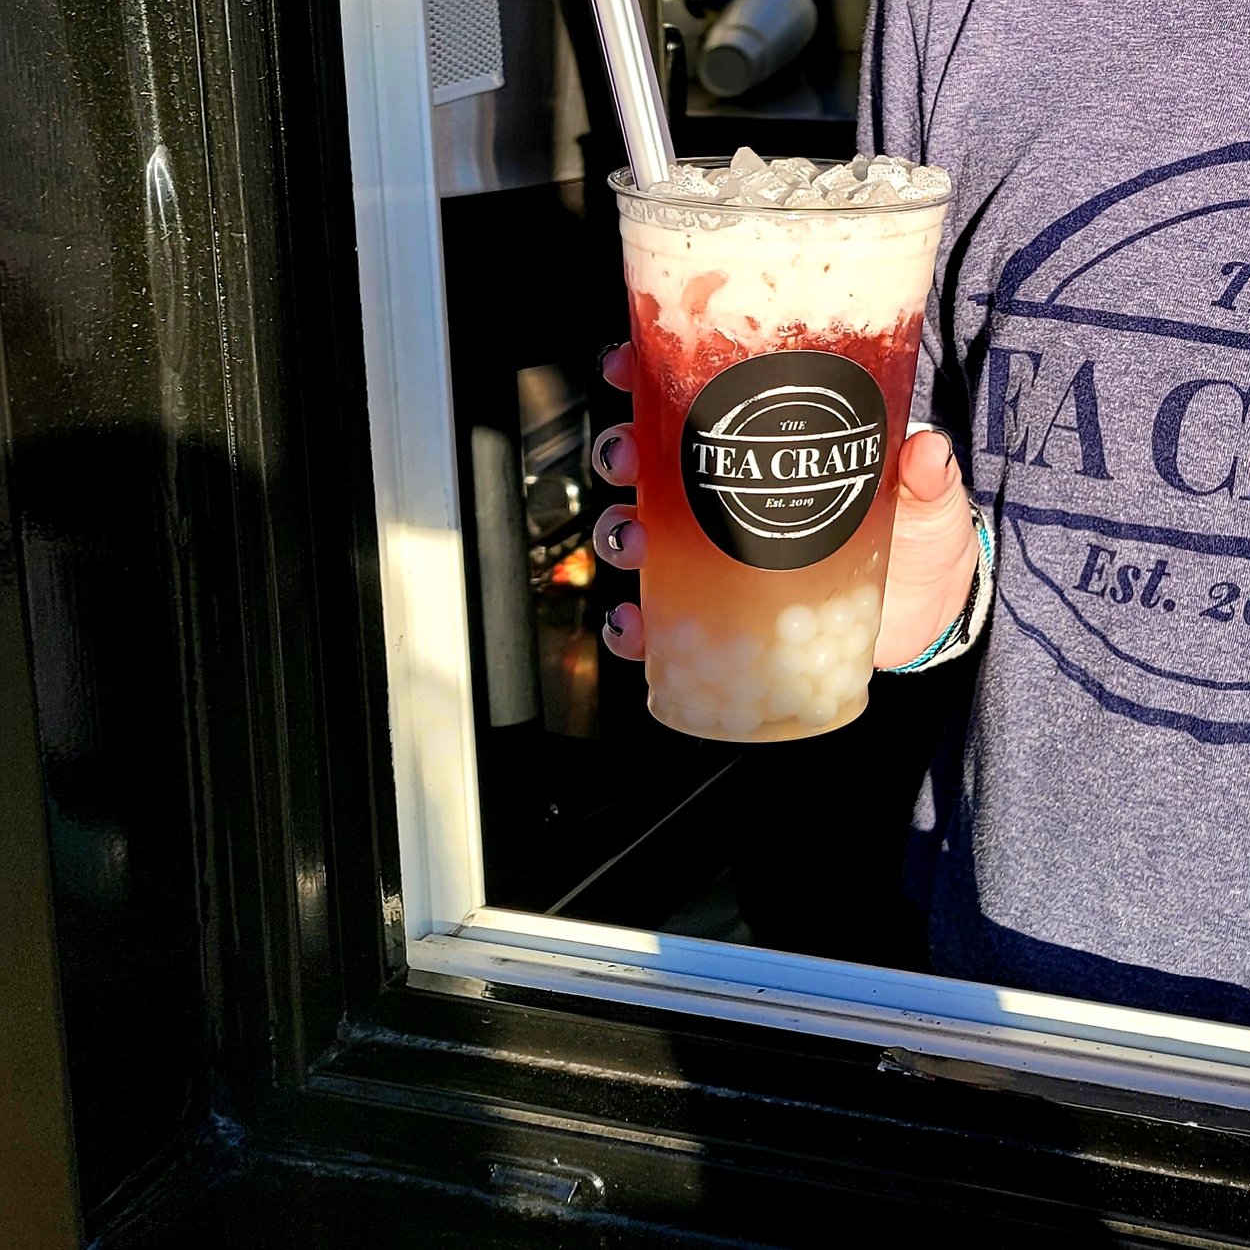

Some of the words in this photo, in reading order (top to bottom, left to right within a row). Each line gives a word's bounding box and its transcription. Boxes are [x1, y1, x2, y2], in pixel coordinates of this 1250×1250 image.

[778, 419, 808, 432] THE
[979, 346, 1115, 481] EA
[692, 441, 764, 481] TEA
[769, 433, 882, 481] CRATE
[764, 497, 787, 509] Est.
[788, 496, 815, 509] 2019
[1073, 543, 1177, 613] Est.
